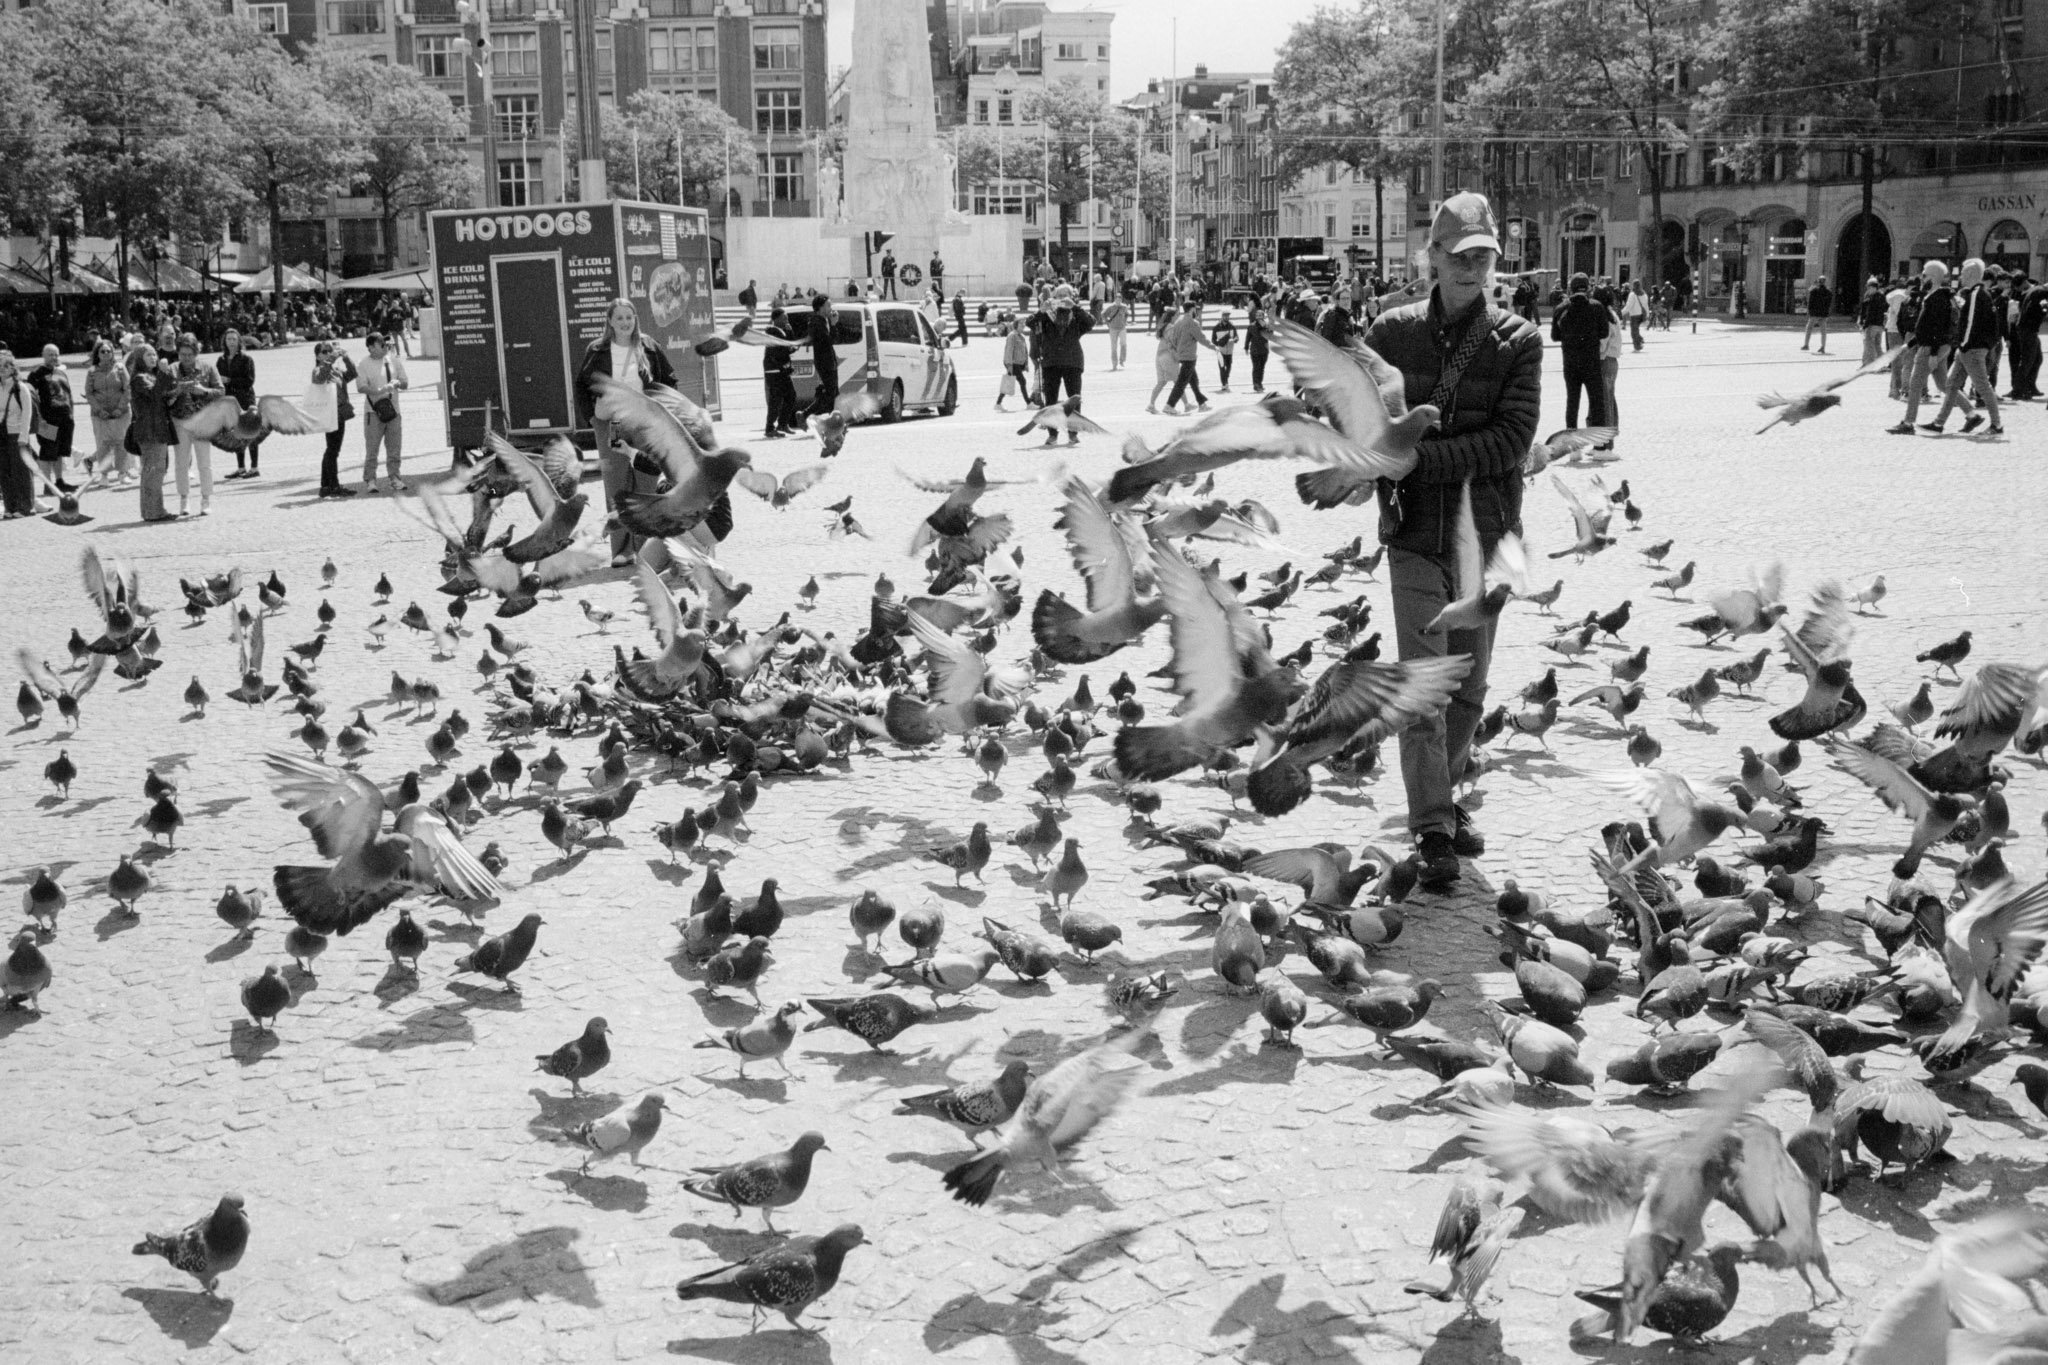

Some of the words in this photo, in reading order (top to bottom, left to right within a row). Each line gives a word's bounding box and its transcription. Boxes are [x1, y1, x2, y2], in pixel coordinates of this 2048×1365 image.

[1978, 194, 2036, 211] GASSAN
[455, 210, 592, 242] HOTDOGS
[568, 258, 584, 267] ICE
[585, 257, 611, 266] COLD
[443, 266, 458, 275] ICE
[459, 264, 485, 273] COLD
[569, 267, 612, 277] DRINKS
[444, 274, 486, 284] DRINKS
